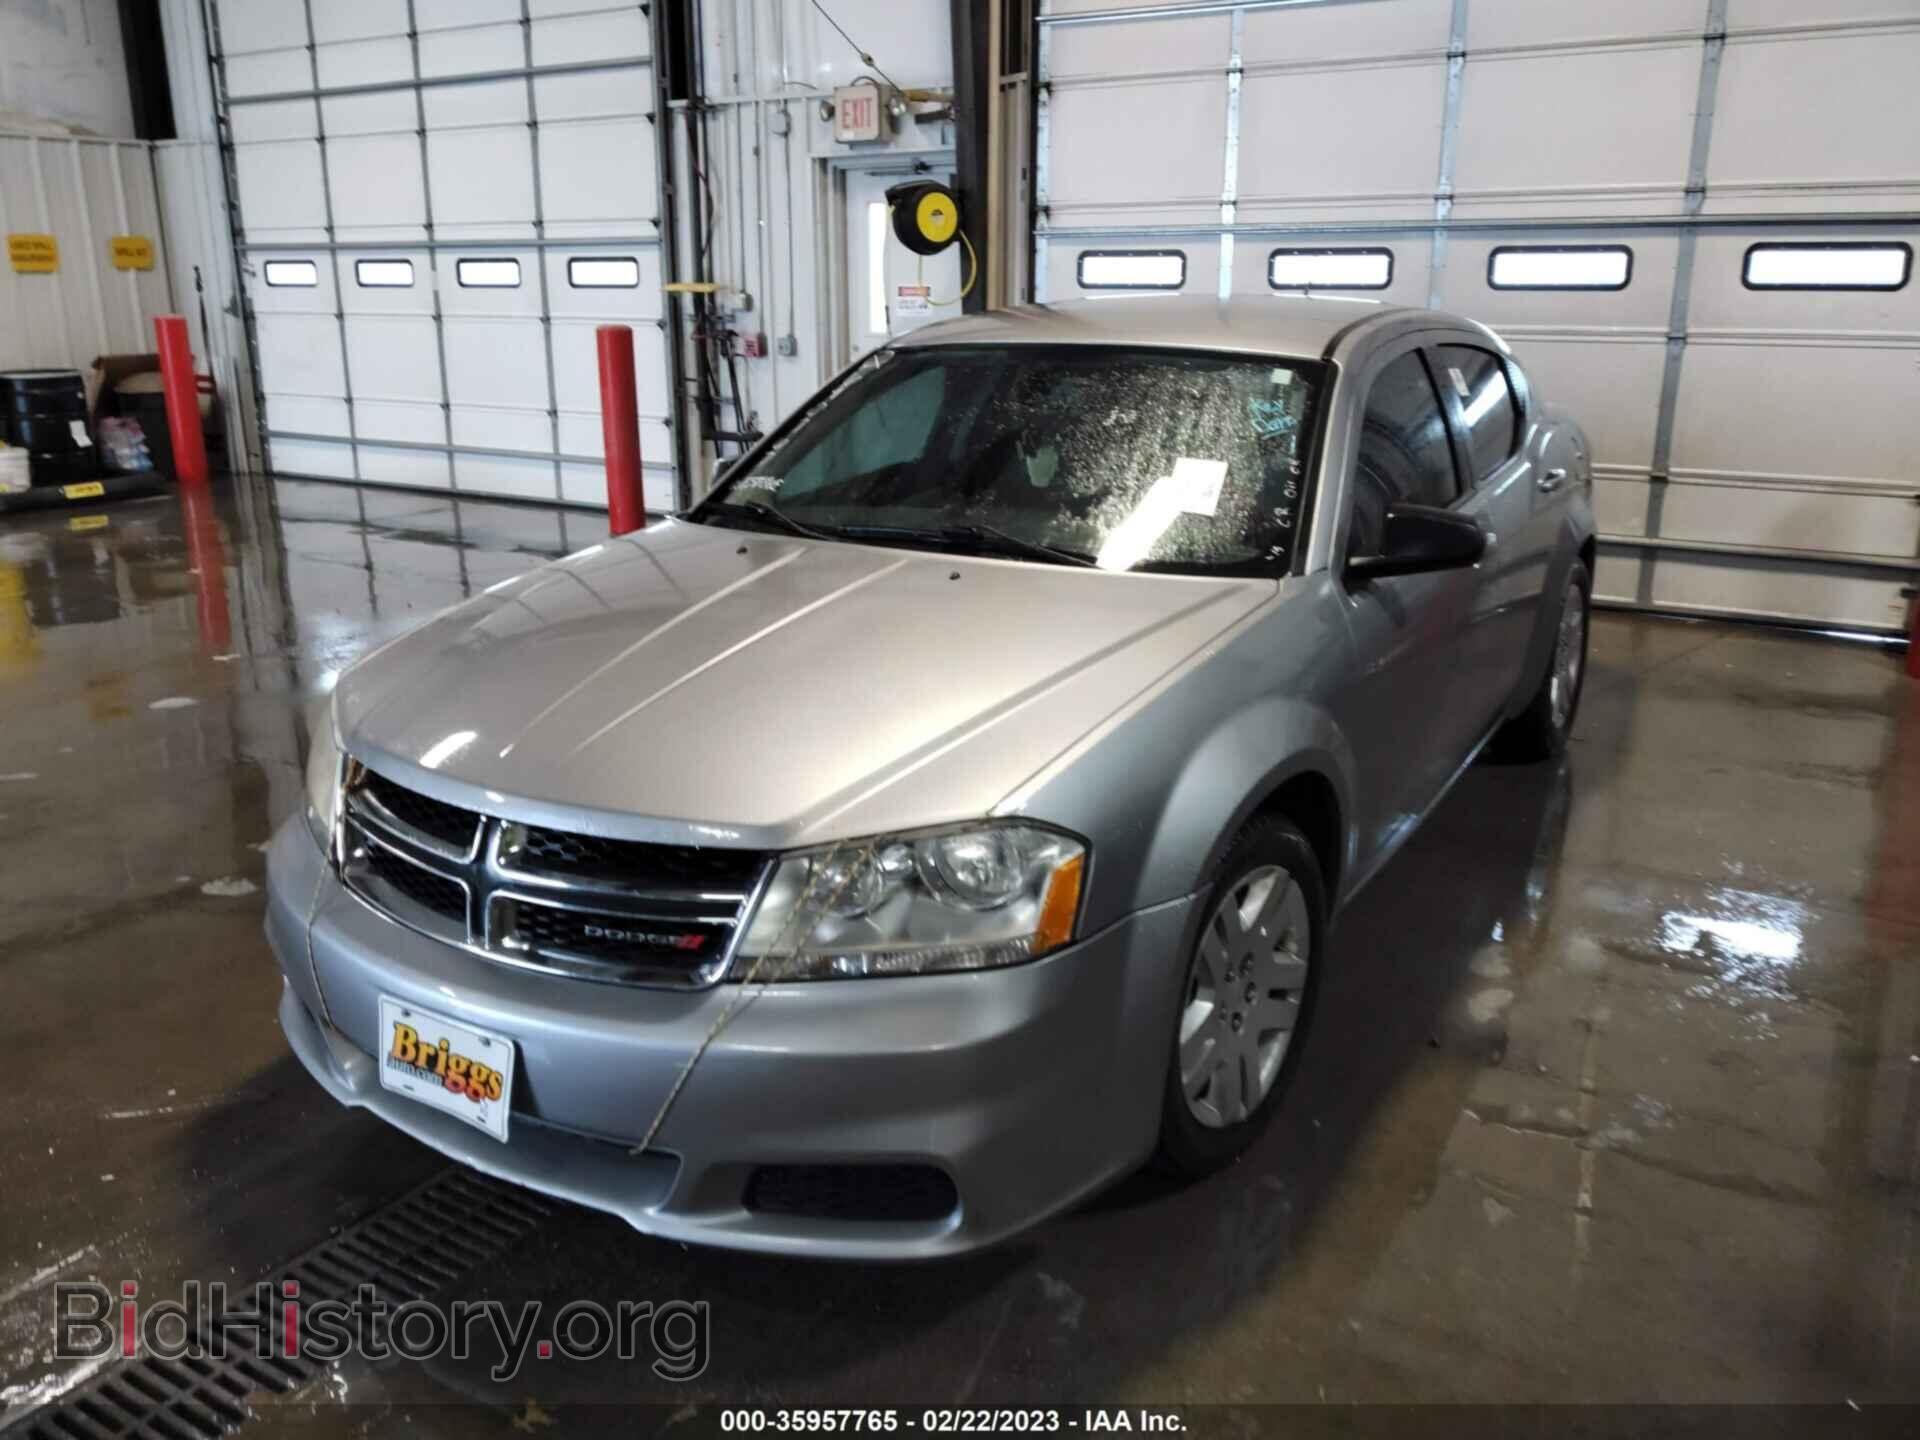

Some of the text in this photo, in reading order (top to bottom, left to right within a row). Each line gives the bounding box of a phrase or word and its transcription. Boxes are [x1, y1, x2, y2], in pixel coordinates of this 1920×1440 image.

[841, 96, 873, 129] EXIT
[584, 924, 684, 948] DODGE
[392, 1020, 504, 1103] Briggs
